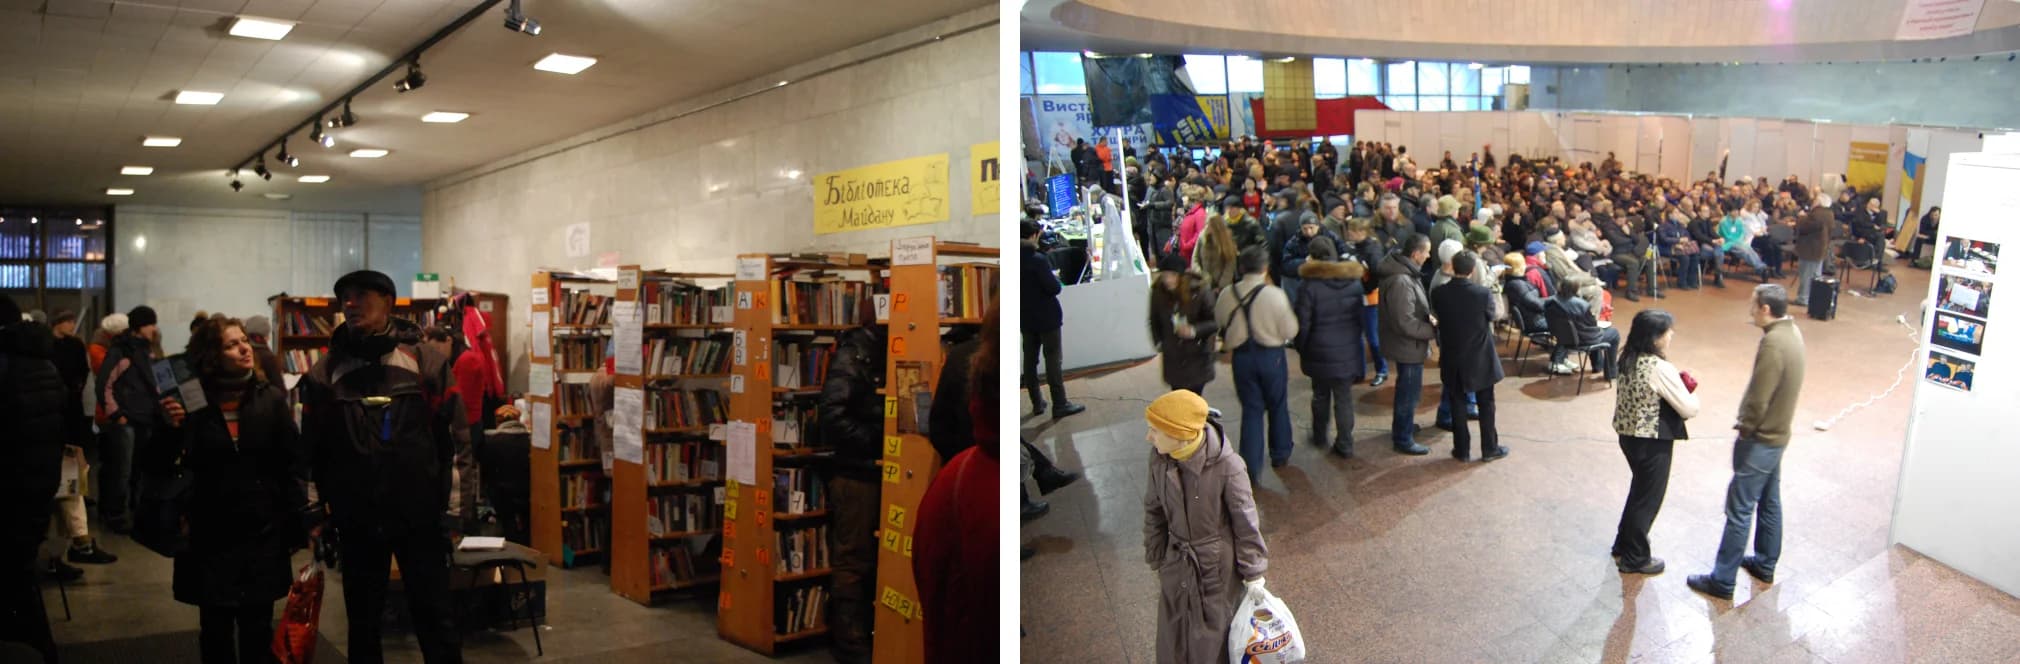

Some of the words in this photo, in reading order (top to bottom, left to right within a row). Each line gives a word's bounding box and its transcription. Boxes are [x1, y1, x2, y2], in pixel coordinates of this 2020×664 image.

[824, 175, 910, 206] Бібліотека
[838, 204, 895, 228] Майдану
[739, 291, 749, 307] А
[756, 291, 765, 308] К
[878, 296, 887, 313] Р
[893, 292, 907, 311] Р
[890, 336, 904, 354] С
[886, 399, 896, 416] Т
[783, 422, 799, 440] М
[887, 438, 899, 454] У
[885, 463, 898, 480] Ф
[886, 535, 897, 547] Ч
[791, 553, 800, 569] О
